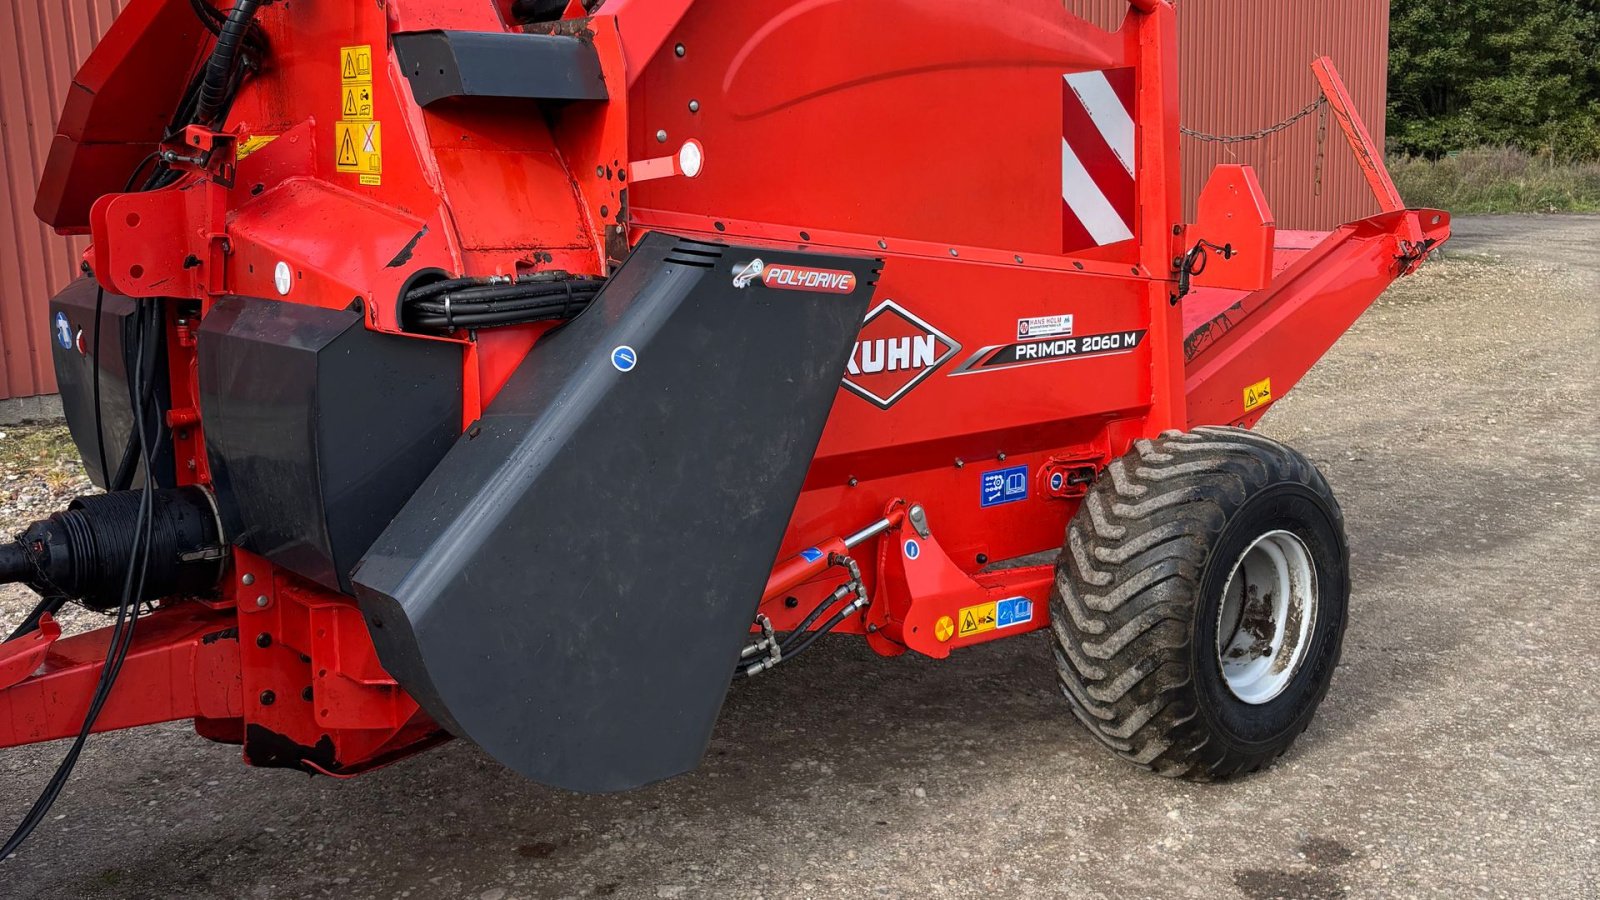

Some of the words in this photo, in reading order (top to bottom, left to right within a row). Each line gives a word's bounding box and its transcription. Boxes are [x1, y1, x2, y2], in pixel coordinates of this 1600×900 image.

[765, 268, 853, 290] POLYDRIVE
[1015, 339, 1076, 360] PRIMOR
[1081, 334, 1120, 352] 2060
[1124, 332, 1136, 347] M
